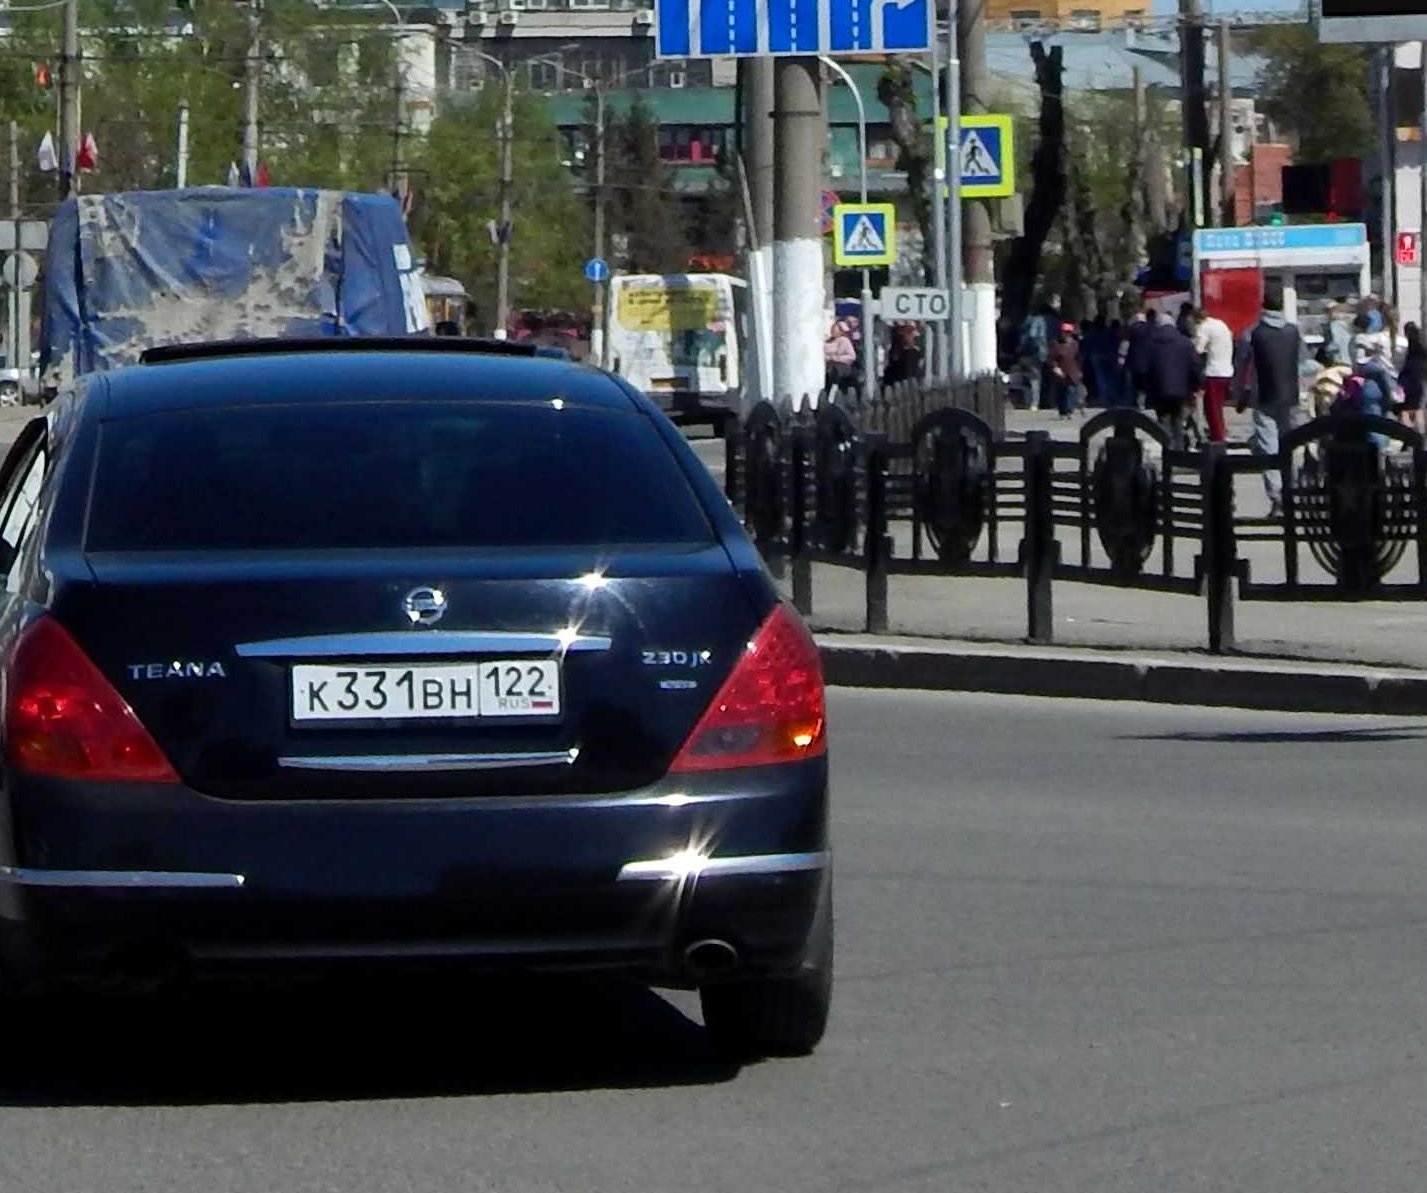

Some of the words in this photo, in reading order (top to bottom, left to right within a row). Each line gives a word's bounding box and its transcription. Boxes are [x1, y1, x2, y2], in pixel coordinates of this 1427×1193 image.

[127, 661, 226, 680] TEANA
[485, 666, 545, 697] 122
[498, 696, 530, 709] RUS
